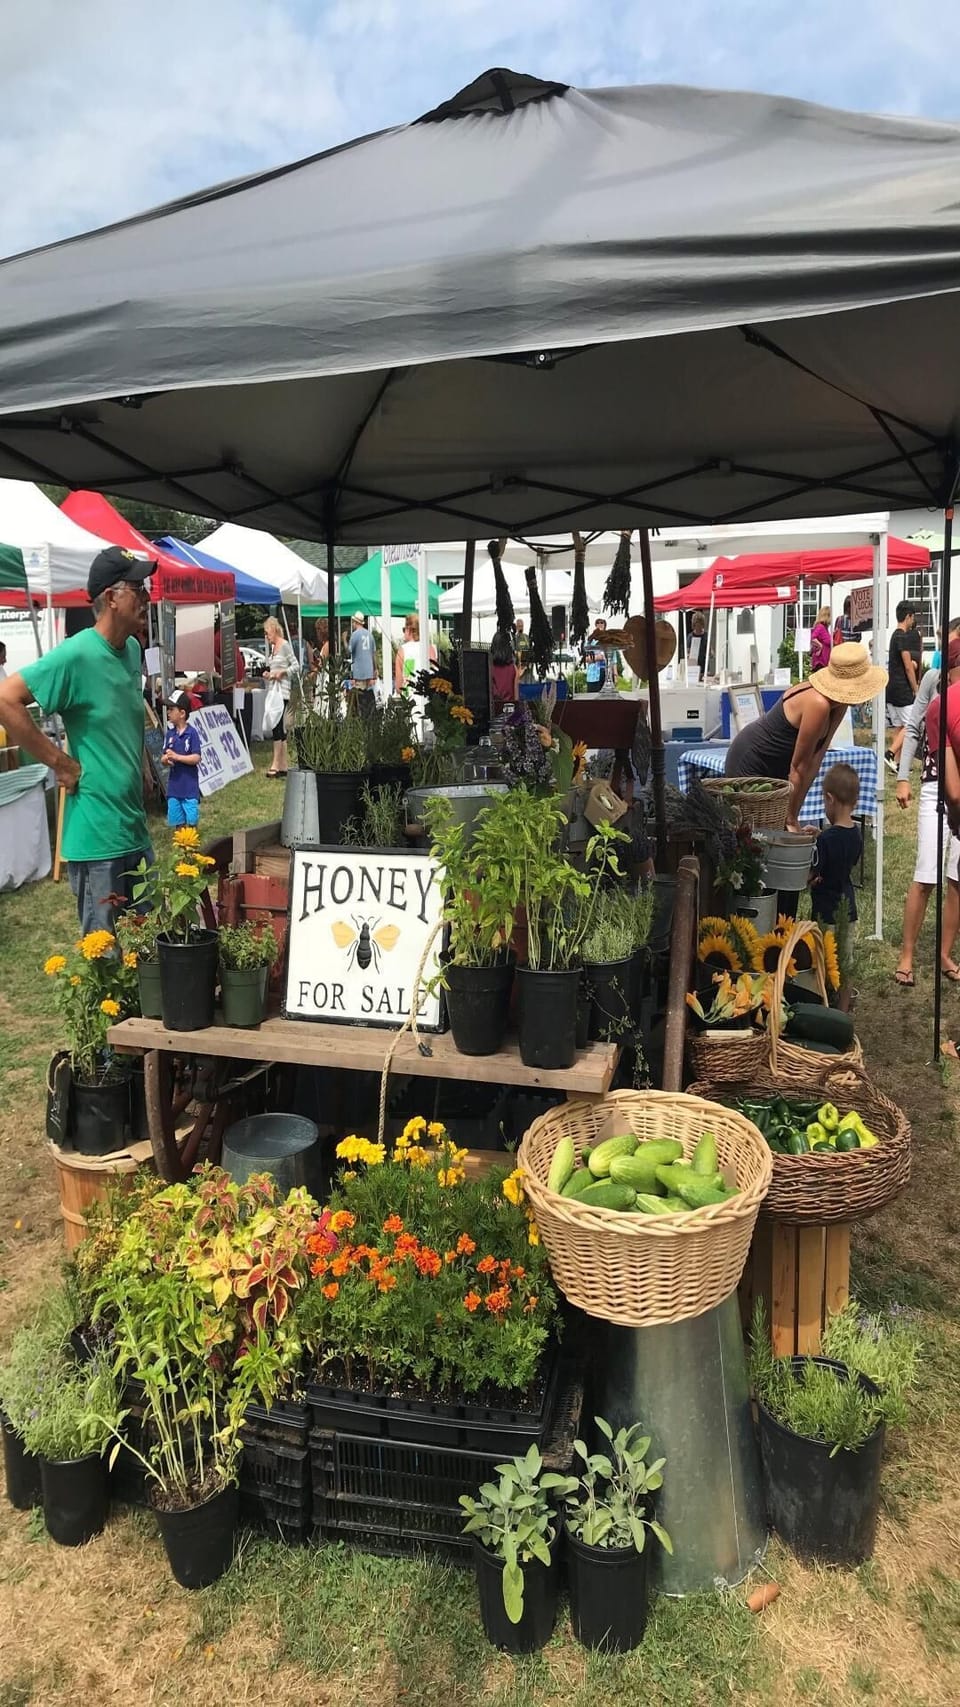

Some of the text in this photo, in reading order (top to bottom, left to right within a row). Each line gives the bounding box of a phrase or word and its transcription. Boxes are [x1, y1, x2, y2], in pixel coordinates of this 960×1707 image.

[851, 589, 870, 605] VOTE
[857, 600, 873, 610] LOCA
[362, 635, 370, 650] 21
[220, 731, 241, 760] $12
[299, 861, 436, 924] HONEY
[297, 981, 346, 1010] FOR
